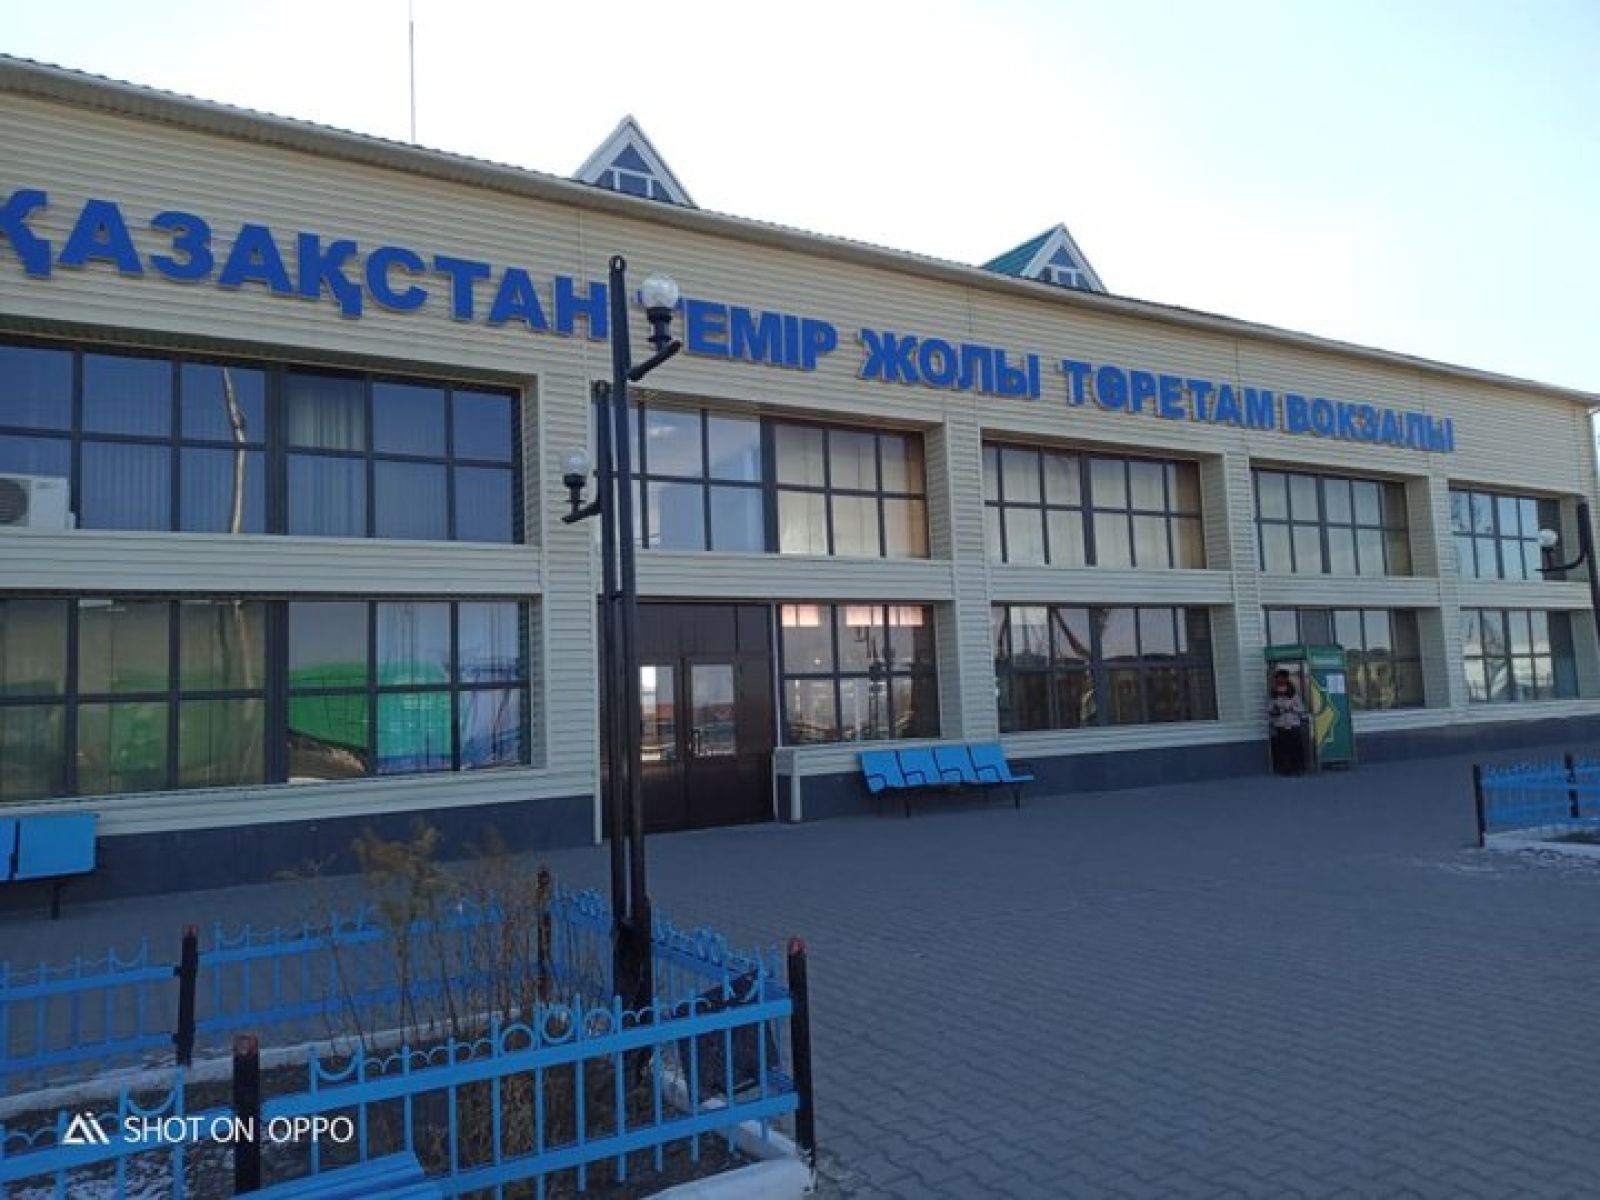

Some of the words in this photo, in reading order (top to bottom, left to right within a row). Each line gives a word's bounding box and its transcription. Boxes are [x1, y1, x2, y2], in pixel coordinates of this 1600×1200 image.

[637, 288, 837, 371] ЕМІР
[857, 328, 1041, 399] ЖОЛЫ
[1061, 359, 1275, 430] ТӨРЕТАМ
[1283, 393, 1454, 453] ВОКЗАЛЫ
